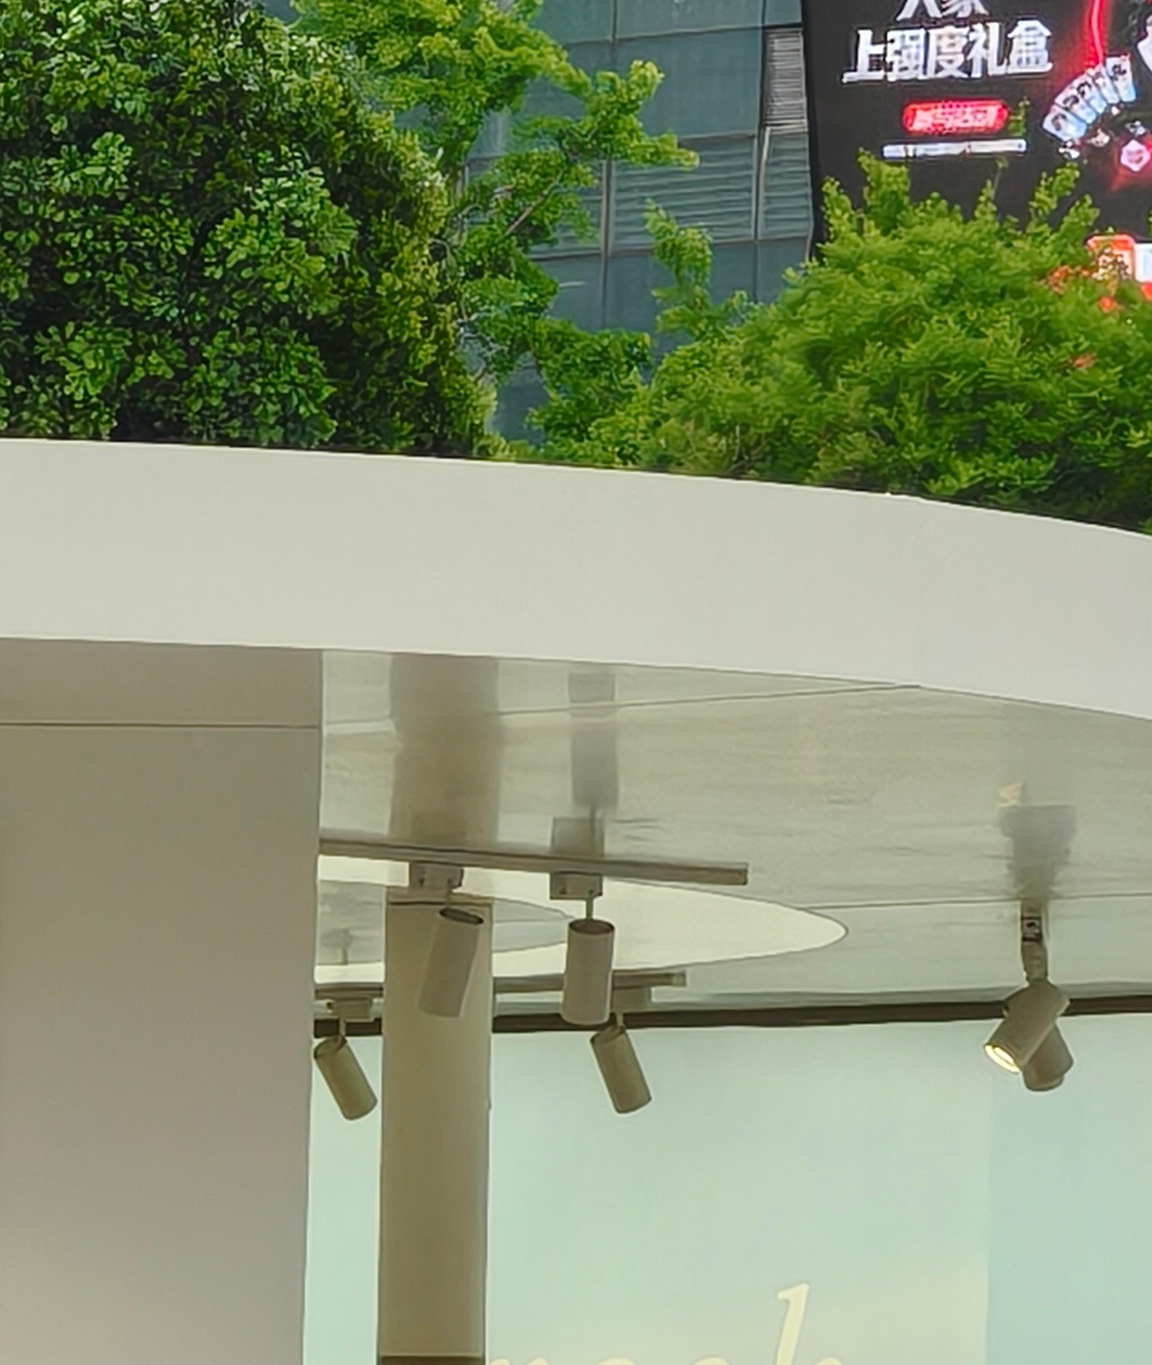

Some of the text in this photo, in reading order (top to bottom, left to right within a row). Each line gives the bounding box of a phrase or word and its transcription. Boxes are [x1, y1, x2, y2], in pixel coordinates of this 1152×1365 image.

[841, 19, 1053, 83] 上强度礼盒
